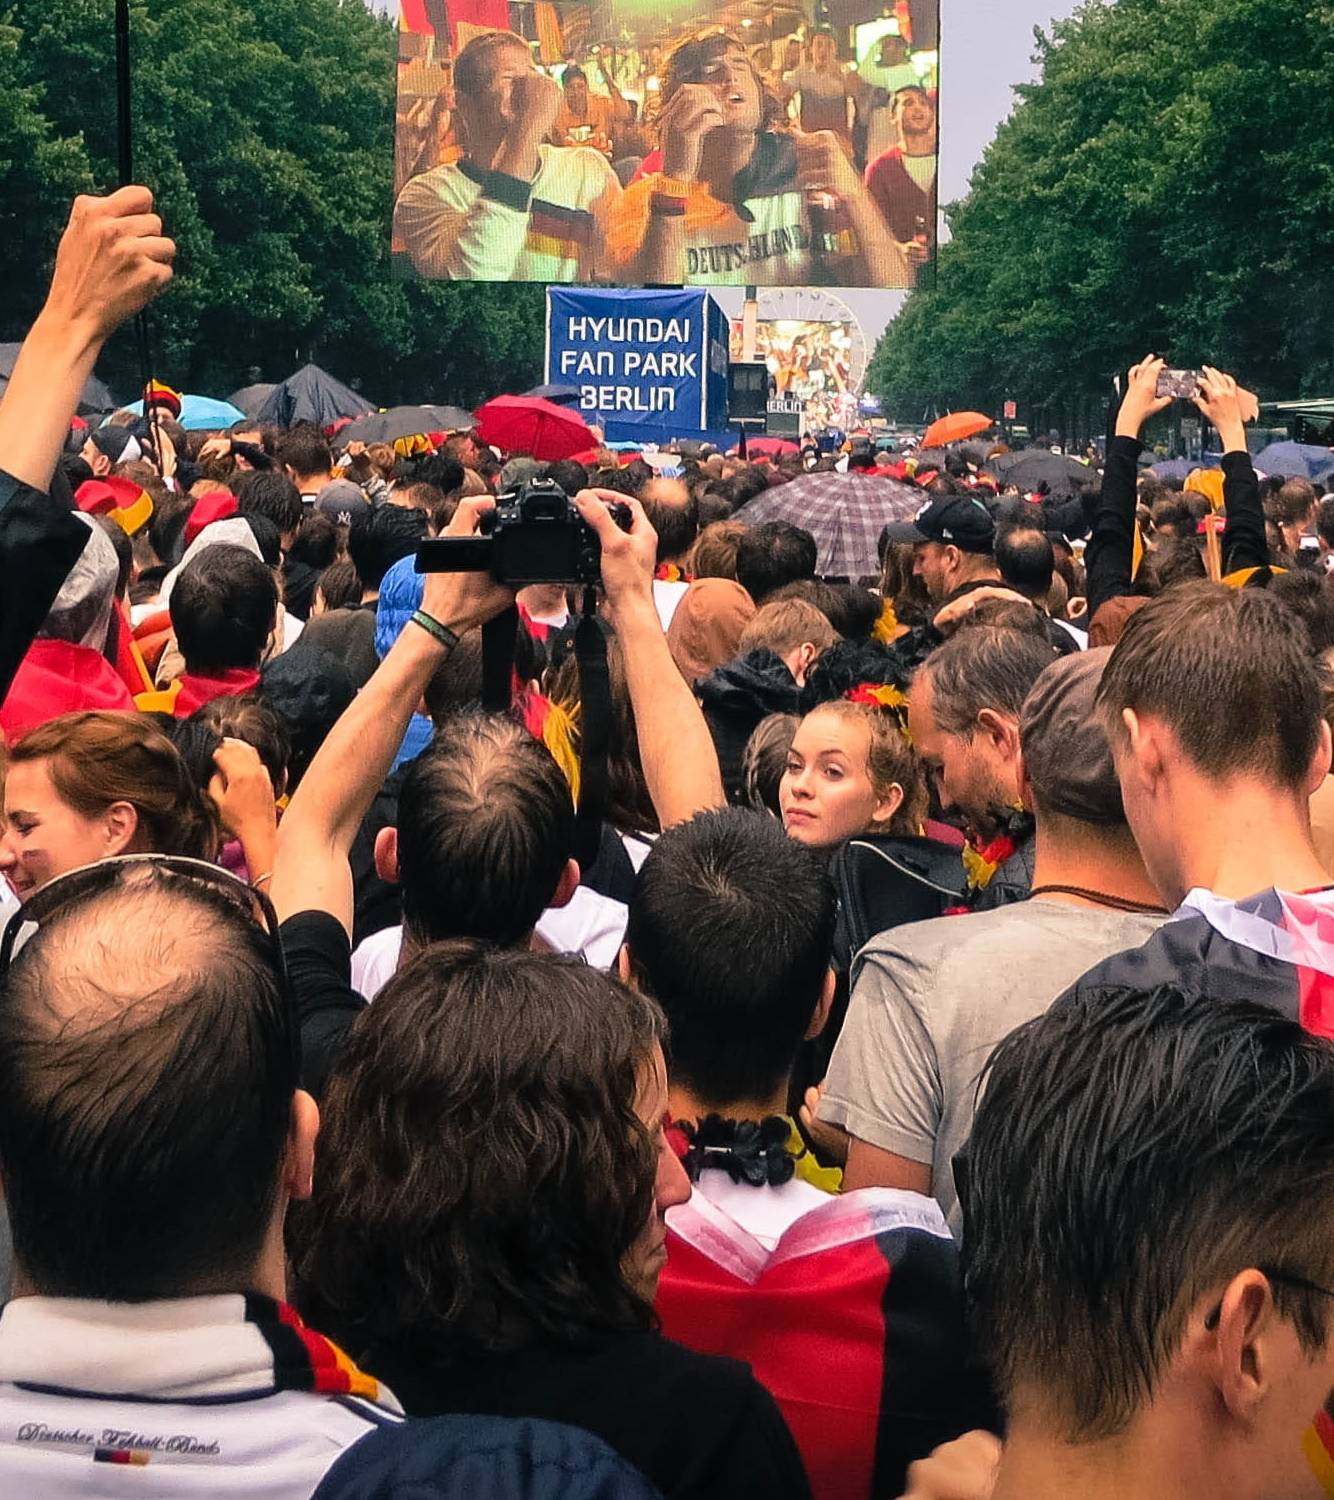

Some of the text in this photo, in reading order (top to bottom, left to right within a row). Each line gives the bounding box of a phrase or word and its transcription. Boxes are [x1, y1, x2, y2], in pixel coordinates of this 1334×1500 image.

[569, 317, 690, 342] HYUNDAI
[561, 351, 614, 376] FAN
[624, 352, 697, 378] PARK
[580, 385, 675, 411] BERLIN
